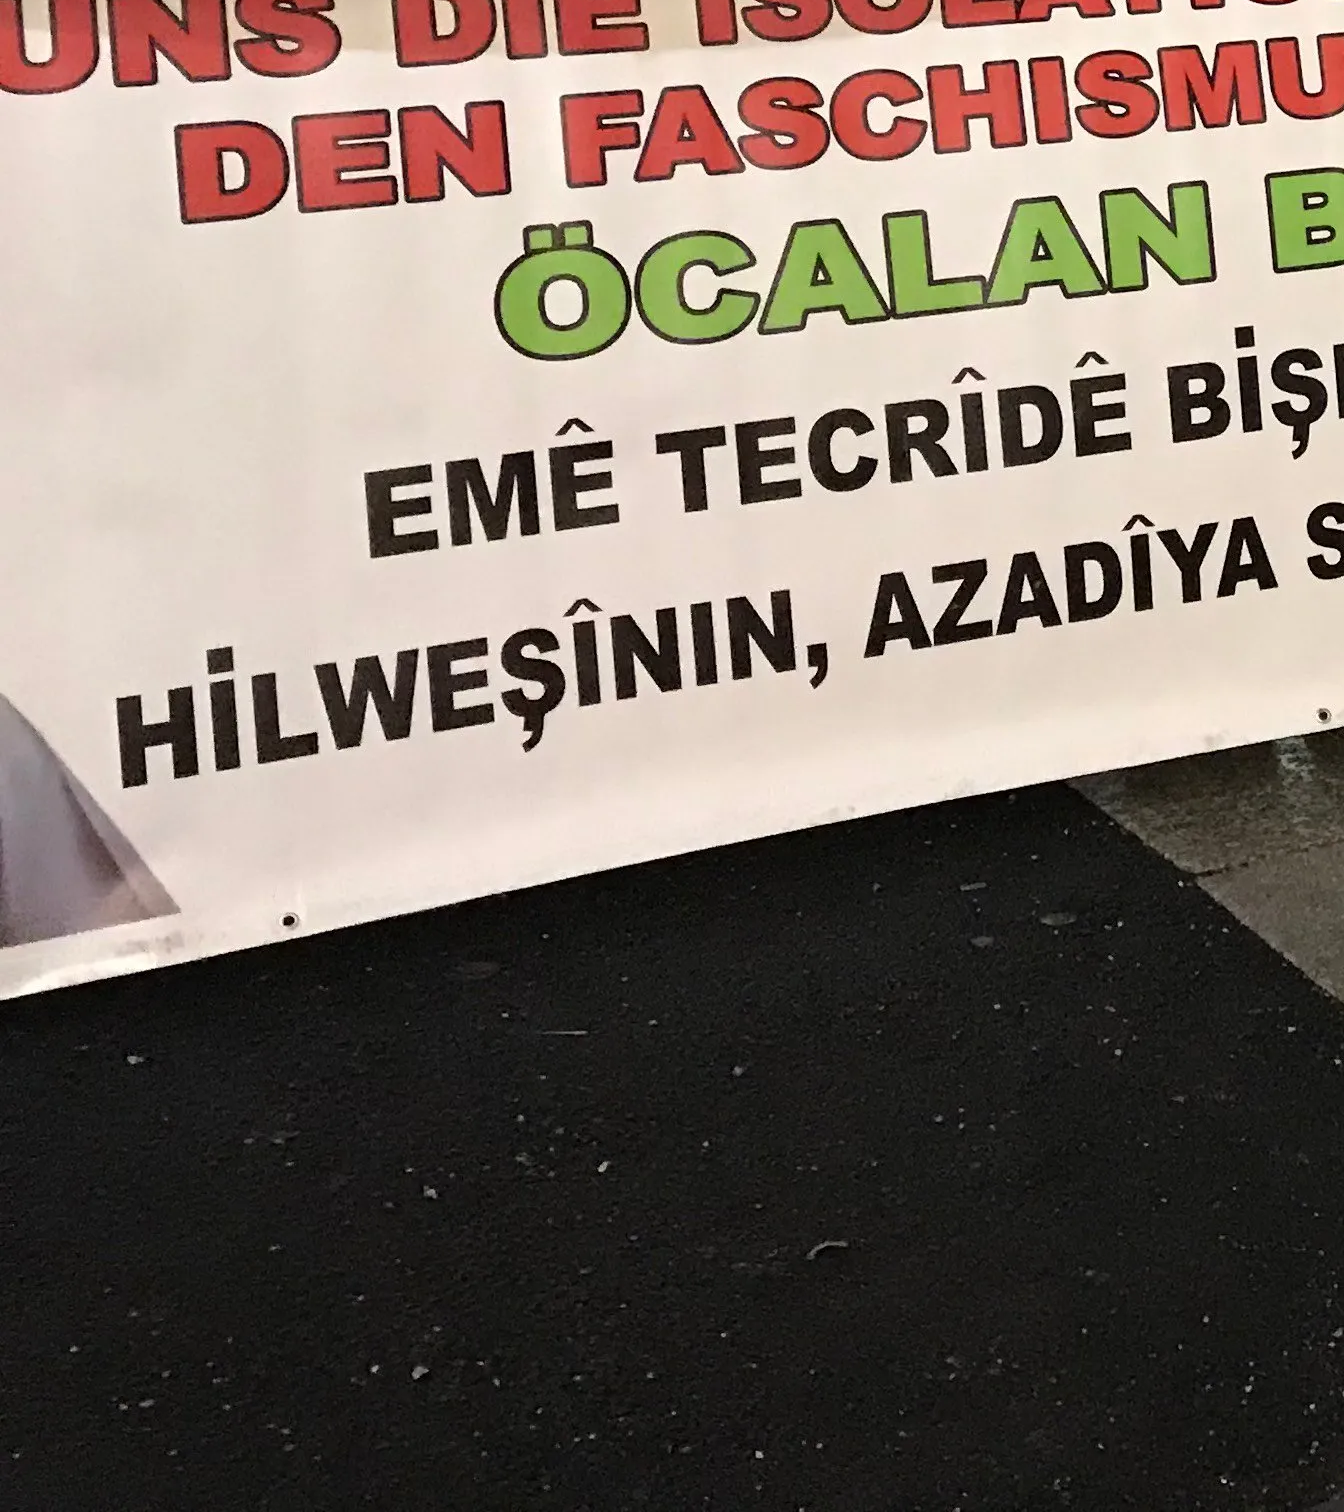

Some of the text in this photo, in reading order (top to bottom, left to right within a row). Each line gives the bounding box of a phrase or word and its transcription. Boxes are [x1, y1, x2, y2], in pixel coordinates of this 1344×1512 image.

[173, 100, 513, 225] DEN
[494, 179, 1216, 362] ÖCALAN
[363, 417, 621, 559] EMÊ
[655, 351, 1132, 514] TECRÎDÊ
[863, 513, 1279, 660] AZADÎYA
